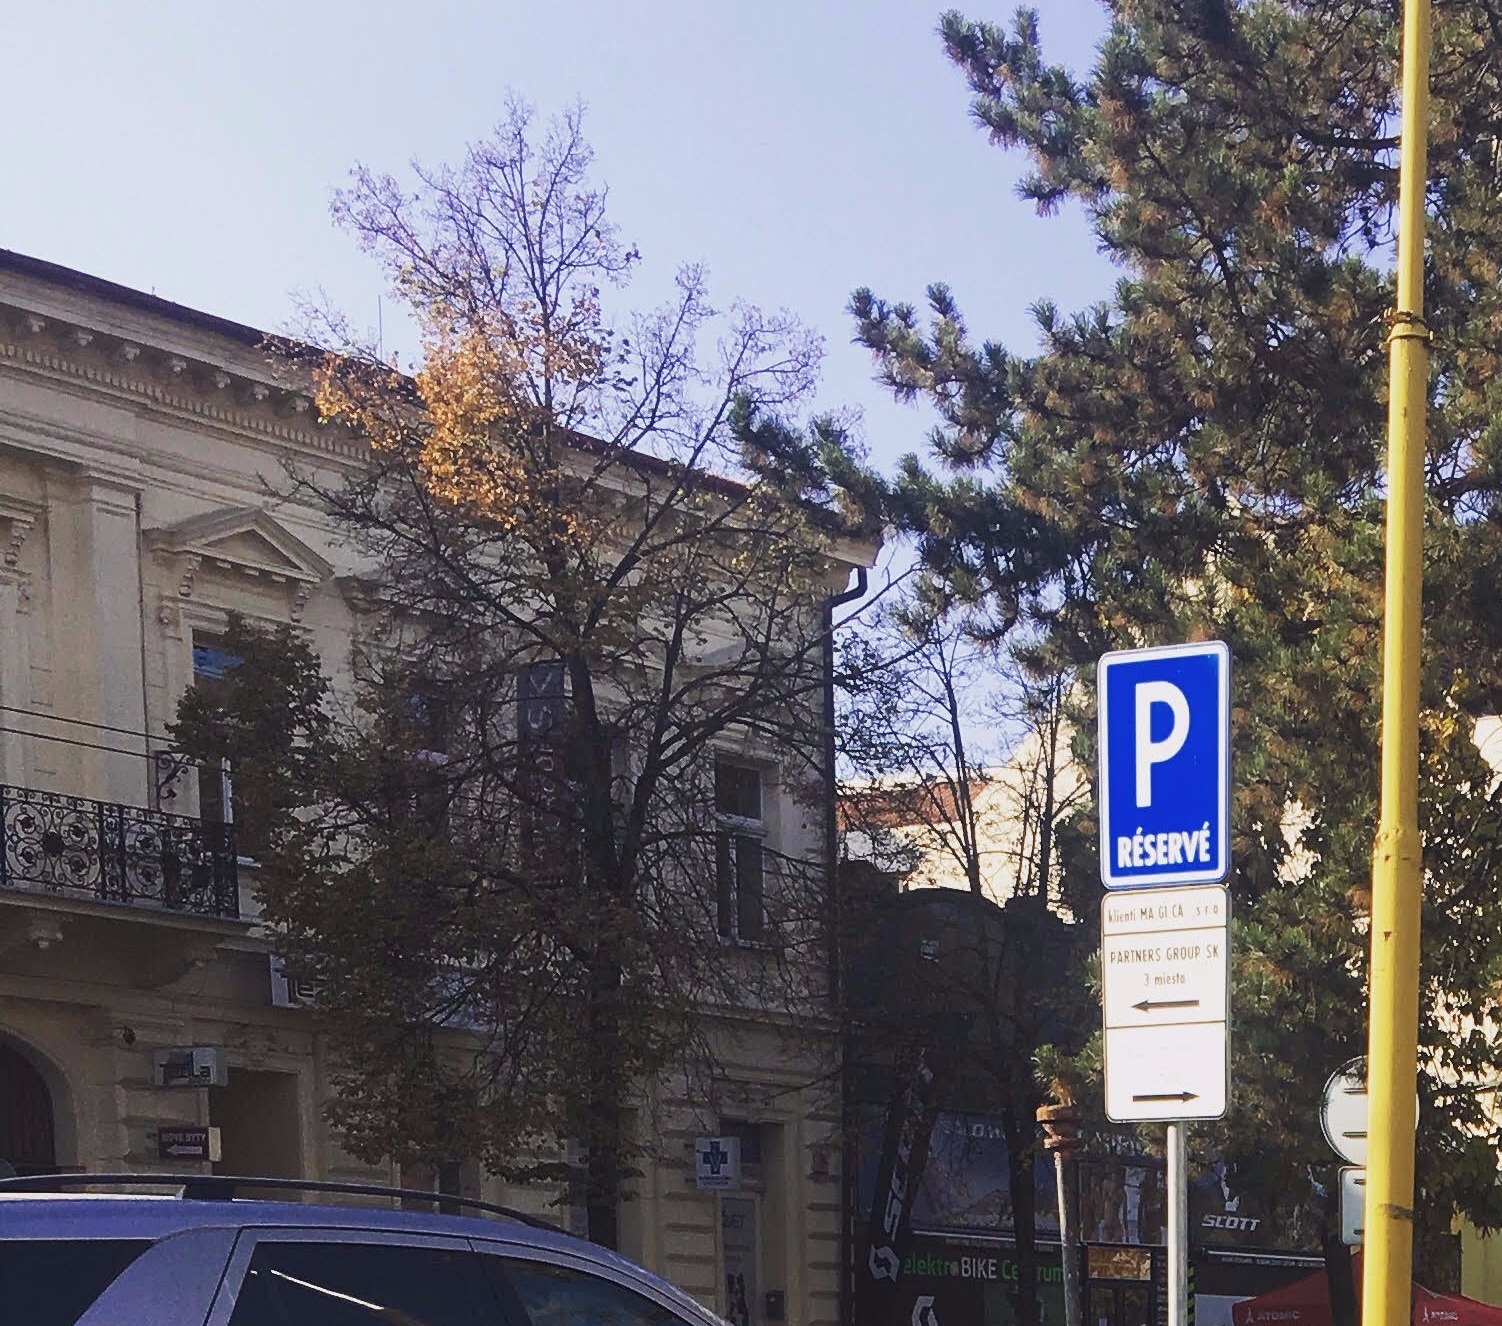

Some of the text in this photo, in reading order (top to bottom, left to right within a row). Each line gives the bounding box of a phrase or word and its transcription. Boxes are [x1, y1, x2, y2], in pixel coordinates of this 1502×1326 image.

[1135, 680, 1190, 808] P
[1117, 821, 1211, 869] RÉSERVÉ
[1110, 944, 1219, 964] PARTNERS GROUP SK
[1202, 1214, 1261, 1231] SCOTT
[1002, 1259, 1065, 1283] Cerum
[1256, 1309, 1301, 1321] ATOMIC
